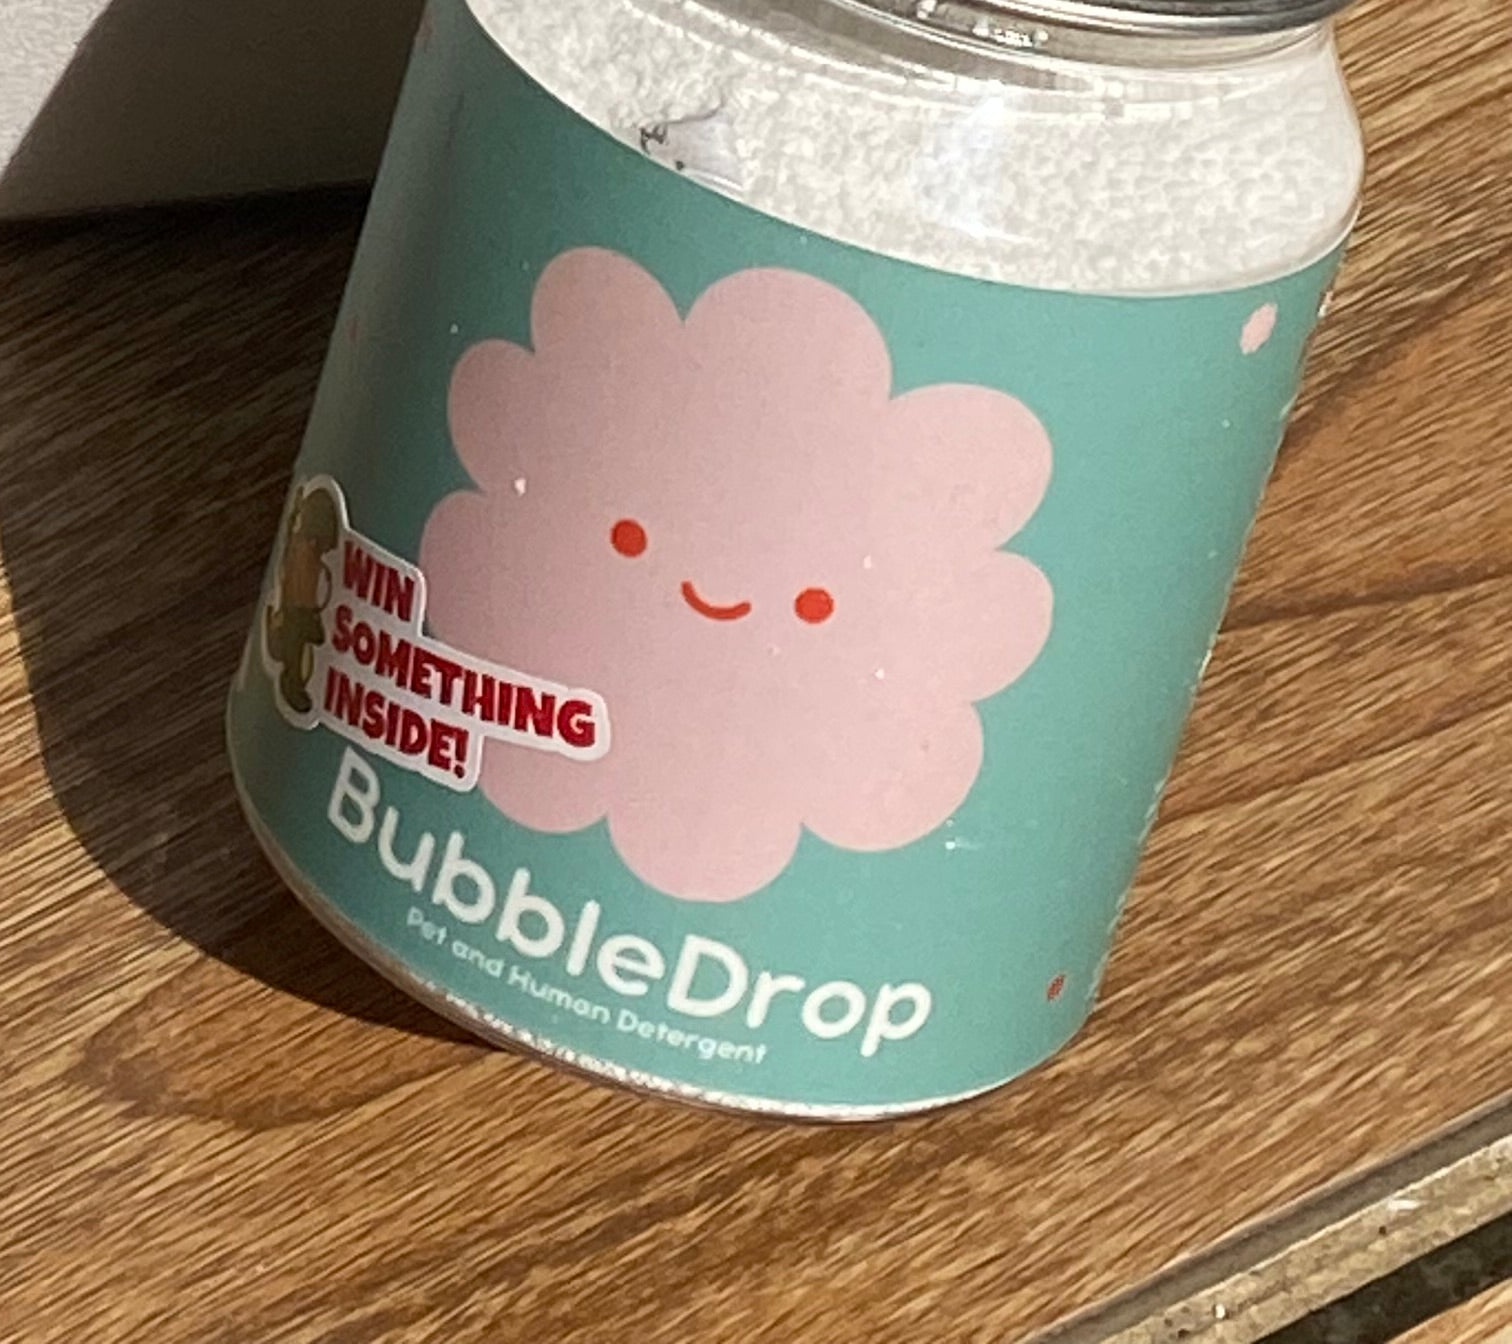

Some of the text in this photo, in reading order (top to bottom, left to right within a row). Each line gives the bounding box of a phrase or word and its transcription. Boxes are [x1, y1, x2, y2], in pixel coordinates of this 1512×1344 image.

[343, 539, 415, 622] WIN
[324, 666, 469, 779] INSIDE!
[331, 604, 596, 748] SOMETHING
[327, 745, 933, 1058] BubbleDrop
[406, 907, 768, 1065] Pet and Human Detergent
